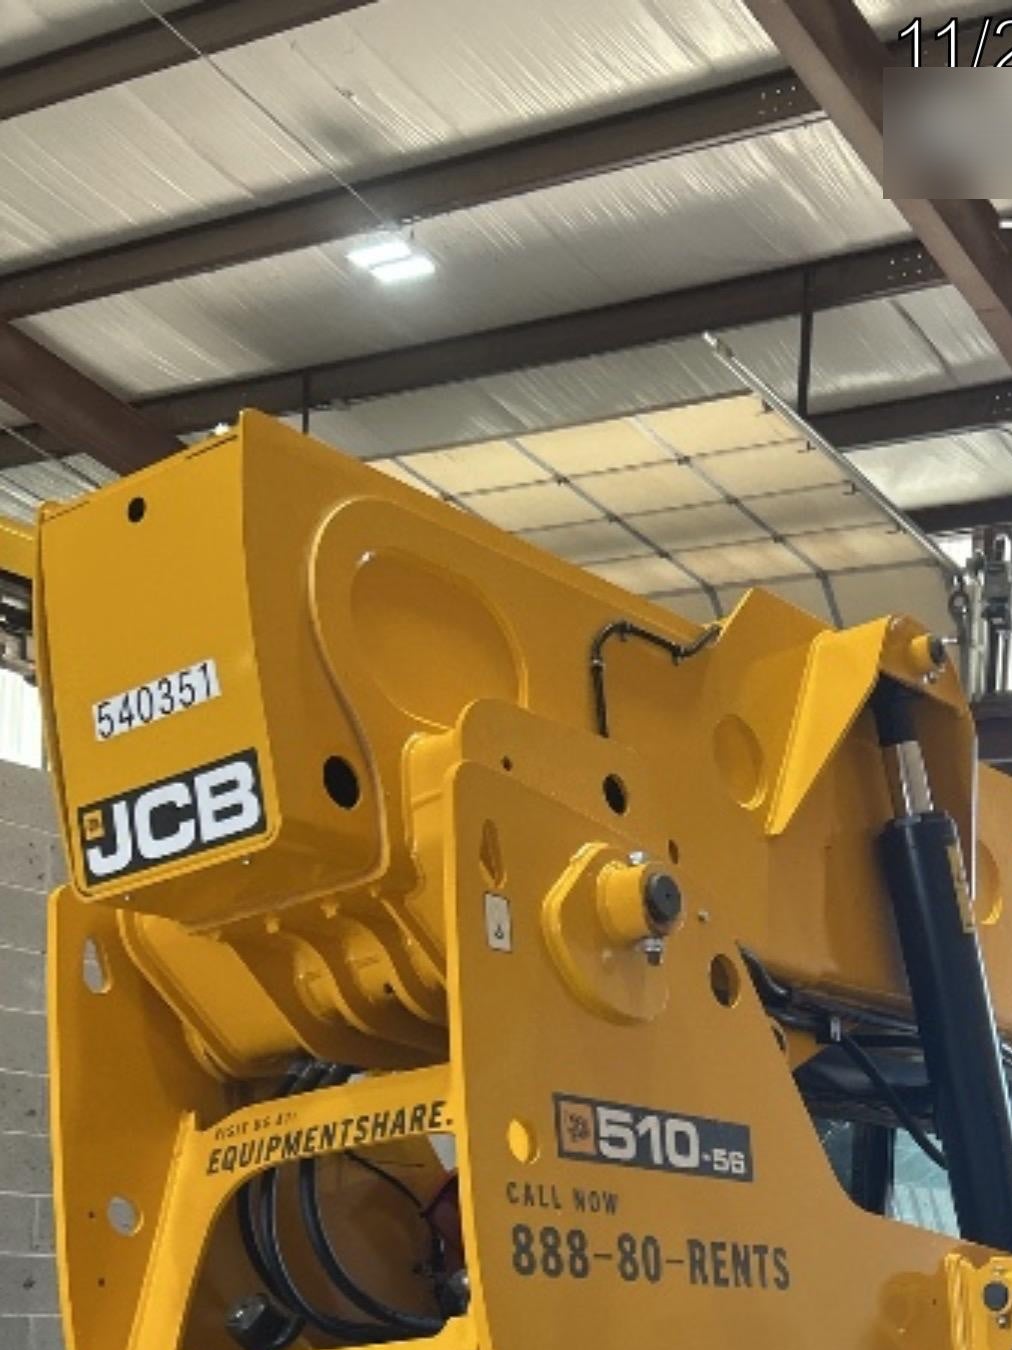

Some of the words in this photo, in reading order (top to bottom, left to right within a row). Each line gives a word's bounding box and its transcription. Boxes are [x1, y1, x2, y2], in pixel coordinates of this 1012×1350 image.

[96, 662, 213, 739] 540351
[87, 761, 261, 877] JCB
[506, 1182, 562, 1210] CALL
[573, 1188, 619, 1215] NOW
[512, 1223, 790, 1290] 888-80-RENTS
